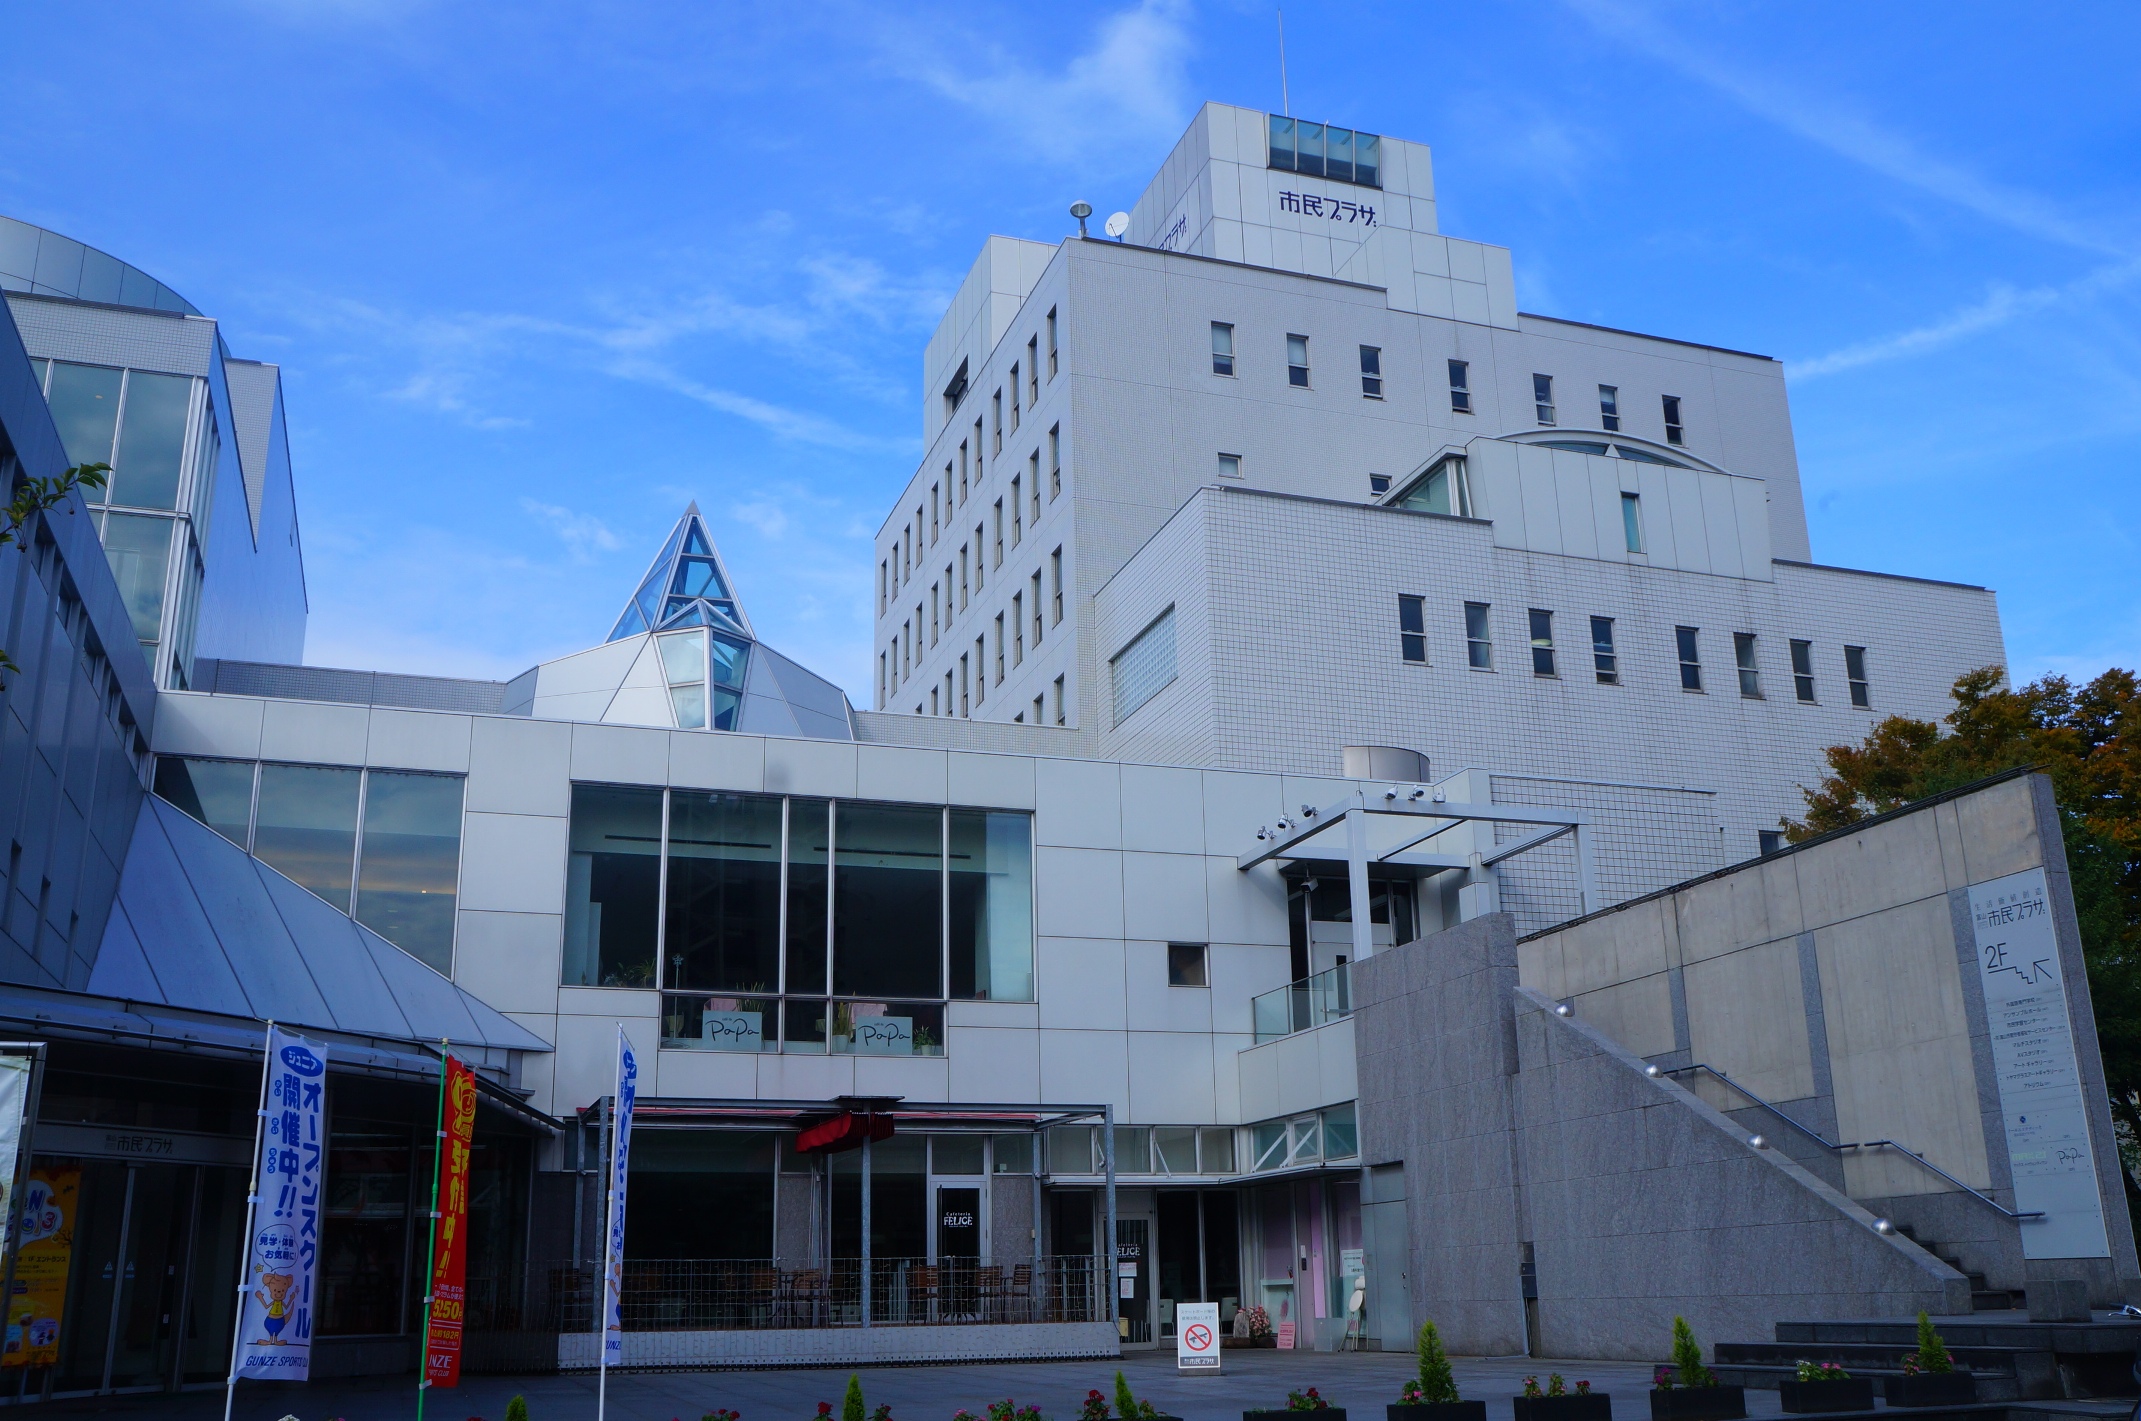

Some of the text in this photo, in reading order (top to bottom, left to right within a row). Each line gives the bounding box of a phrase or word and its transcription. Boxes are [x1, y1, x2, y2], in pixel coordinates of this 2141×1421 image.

[1279, 190, 1377, 227] 市民プラザ
[1987, 898, 2046, 928] 市民プラザ
[1985, 942, 2008, 969] 2F
[288, 1050, 318, 1071] ジュニア
[117, 1136, 173, 1154] 市民プラザ
[295, 1083, 322, 1339] オープンスクール
[943, 1216, 973, 1226] FELICE
[1116, 1247, 1141, 1256] ELICE
[605, 1340, 621, 1352] UNZ
[246, 1355, 278, 1367] GUNZE
